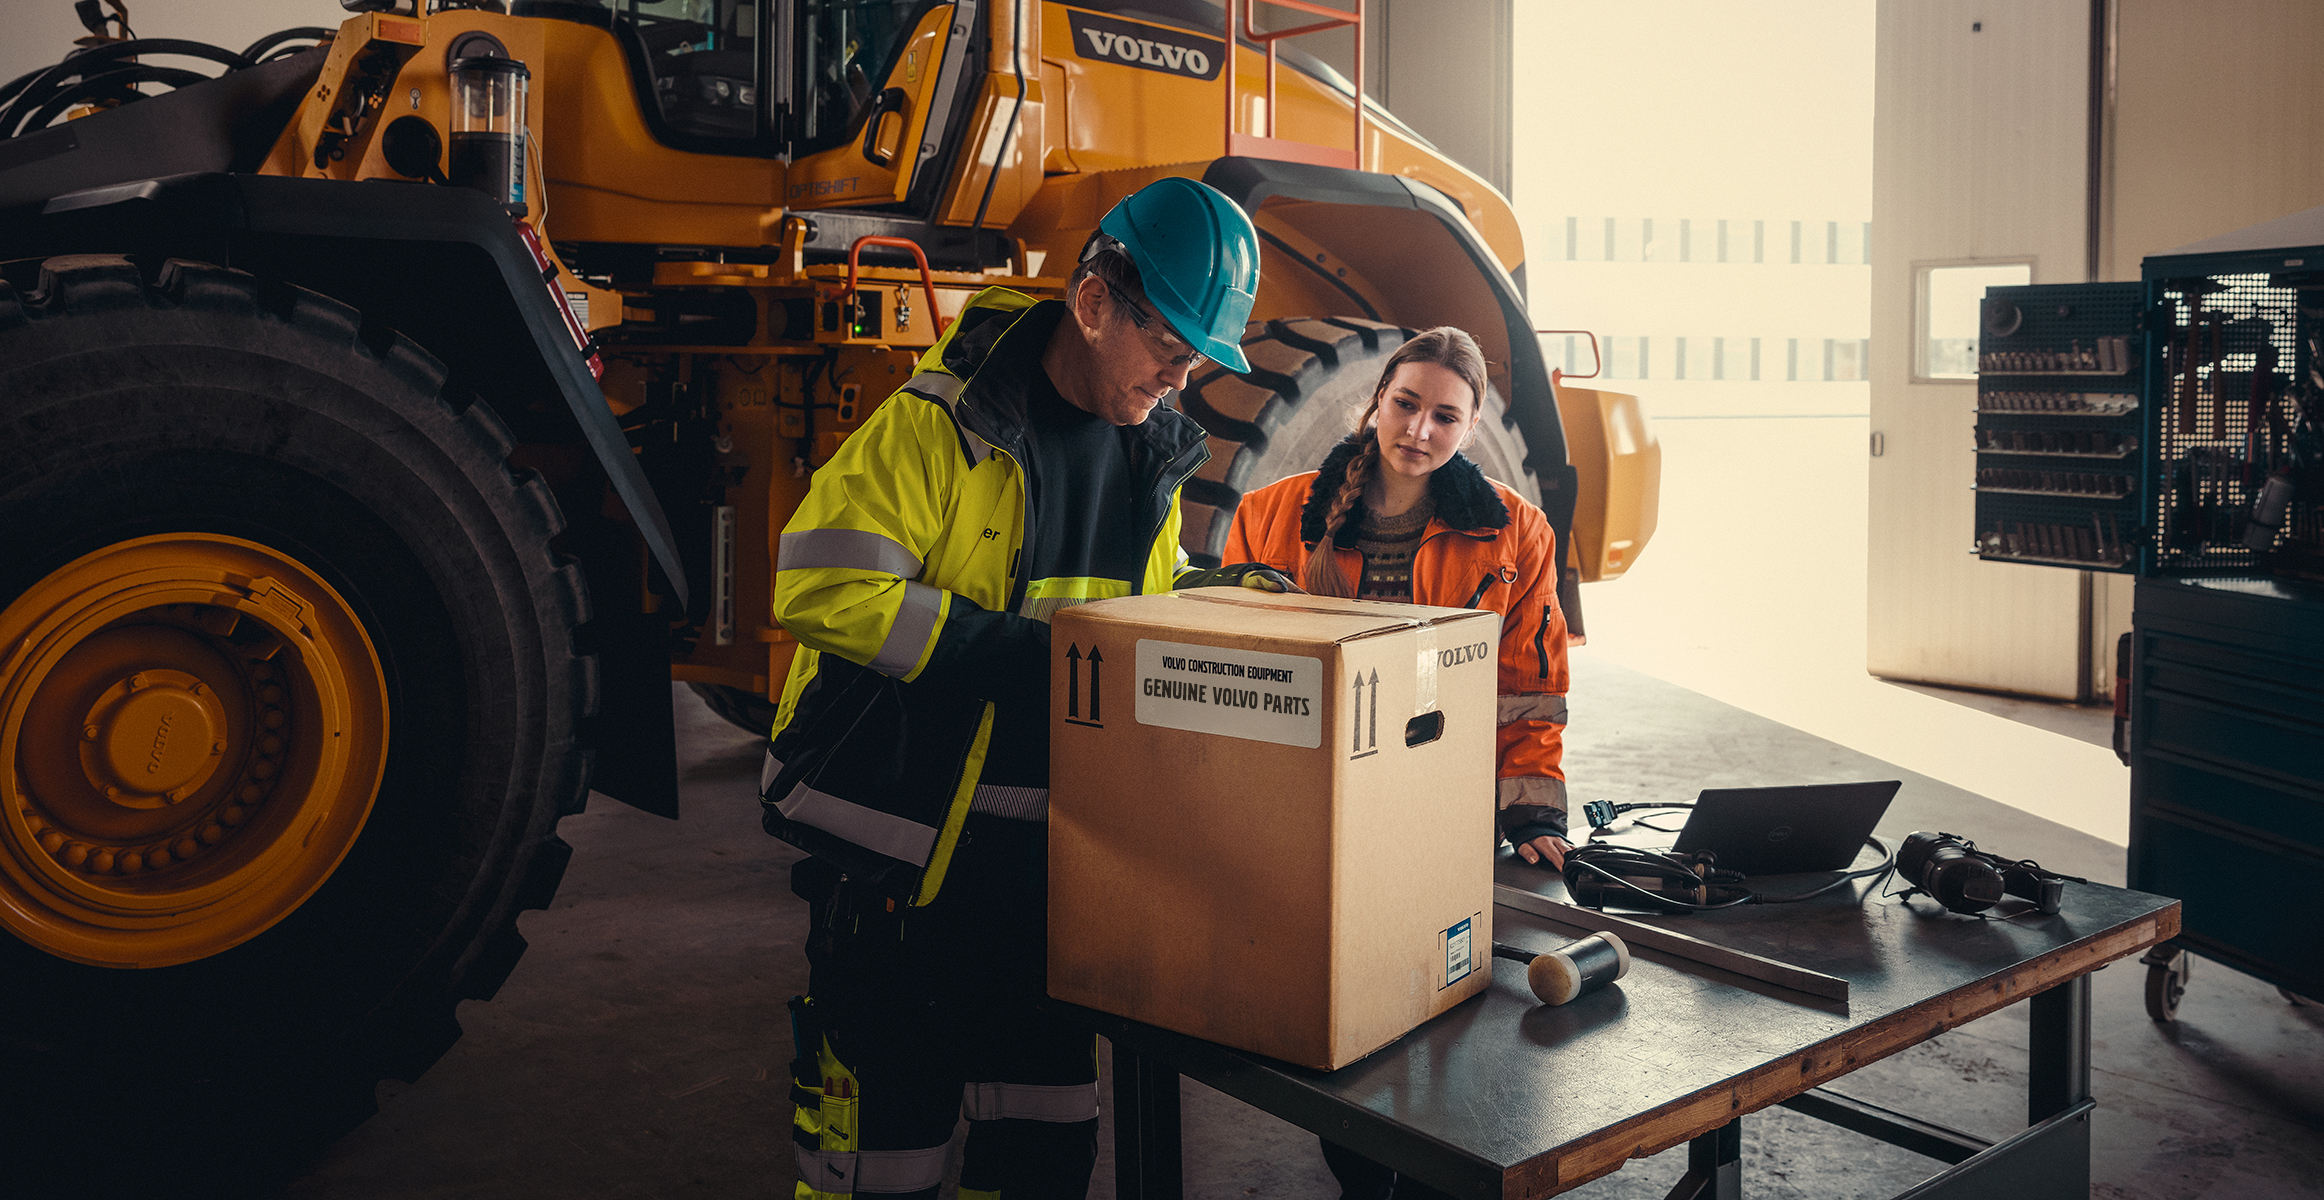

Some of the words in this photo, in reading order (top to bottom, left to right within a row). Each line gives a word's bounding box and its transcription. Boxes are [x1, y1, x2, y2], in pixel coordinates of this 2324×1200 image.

[1082, 28, 1210, 75] VOLVO
[789, 177, 860, 199] OPTISHIFT
[1162, 655, 1186, 671] VOLVO
[1188, 659, 1245, 678] CONSTRUCTION
[1247, 665, 1293, 684] EQUIPMENT
[1143, 677, 1207, 704] GENUINE
[1212, 686, 1258, 710] VOLVO
[1263, 692, 1310, 717] PARTS
[147, 711, 175, 774] VOLVO
